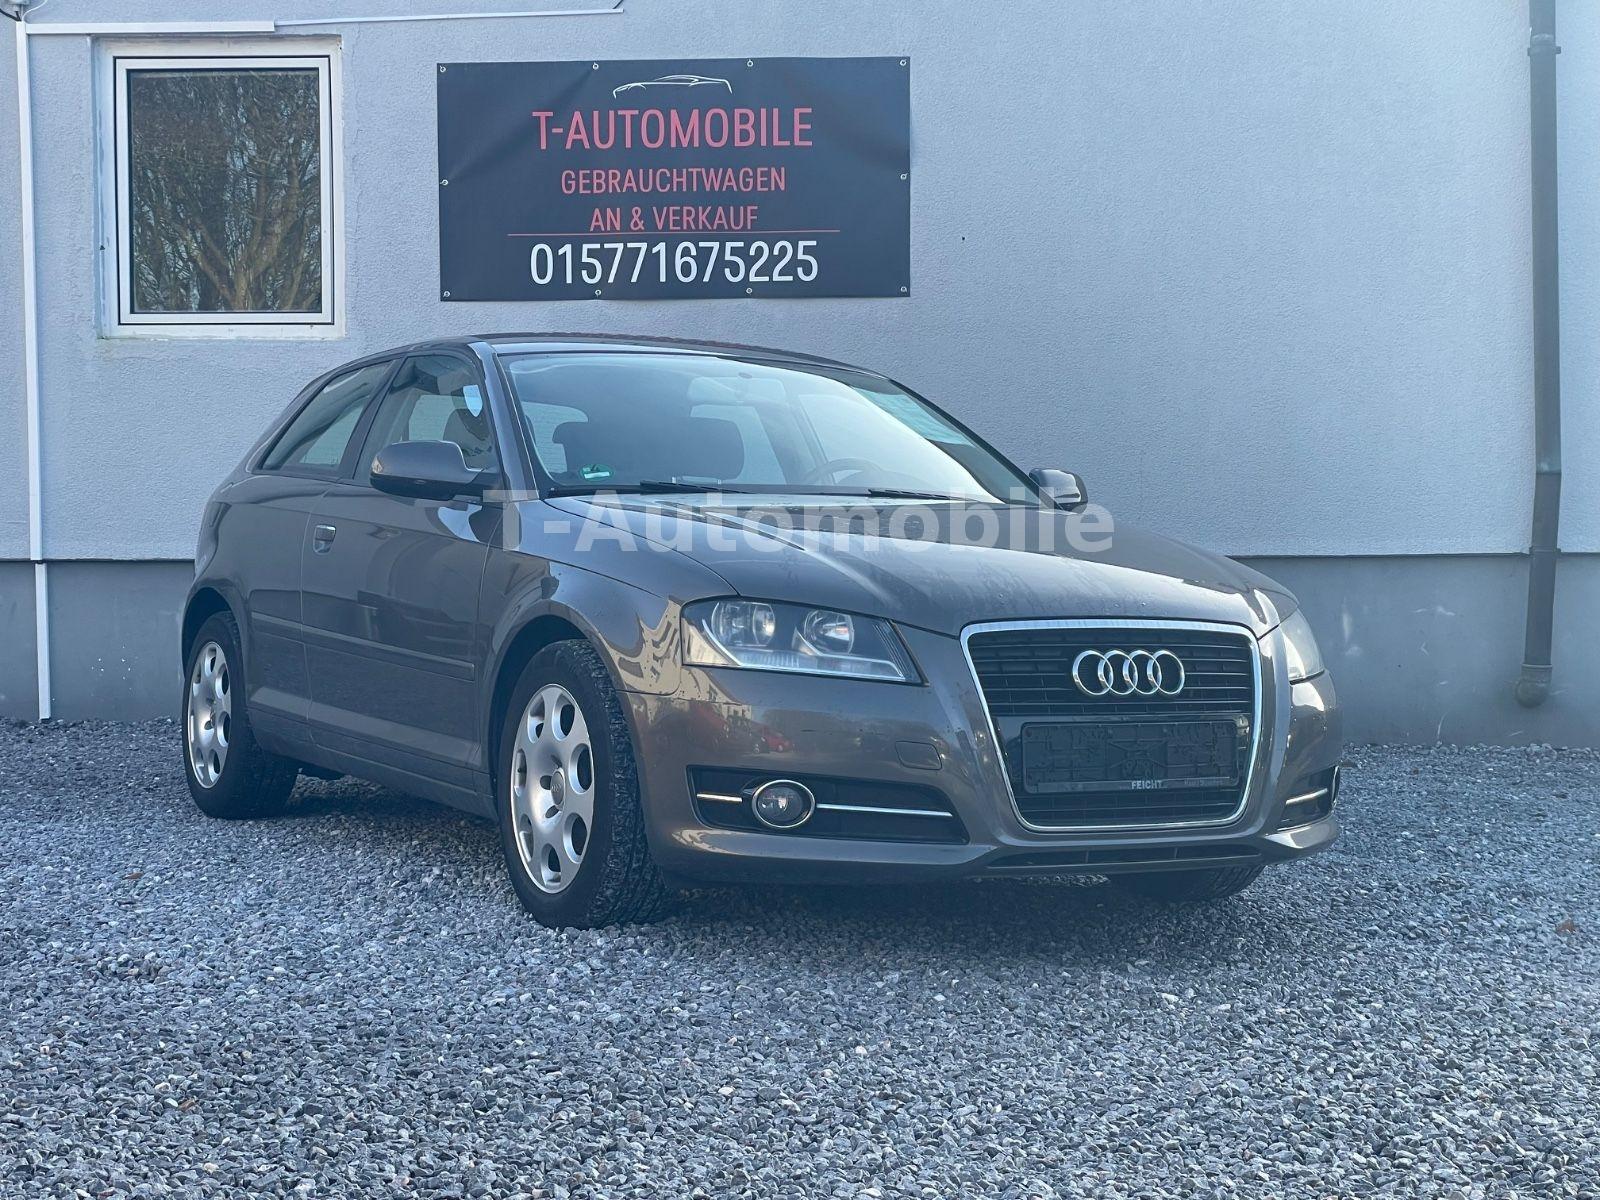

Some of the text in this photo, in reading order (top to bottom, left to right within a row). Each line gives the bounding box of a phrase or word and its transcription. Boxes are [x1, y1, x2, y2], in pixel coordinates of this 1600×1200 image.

[532, 107, 813, 150] T-AUTOMOBILE
[561, 166, 786, 194] GEBRAUCHTWAGEN
[590, 205, 759, 232] AN & VERKAUF
[530, 240, 819, 285] 015771675225
[1131, 779, 1164, 790] FEICHT
